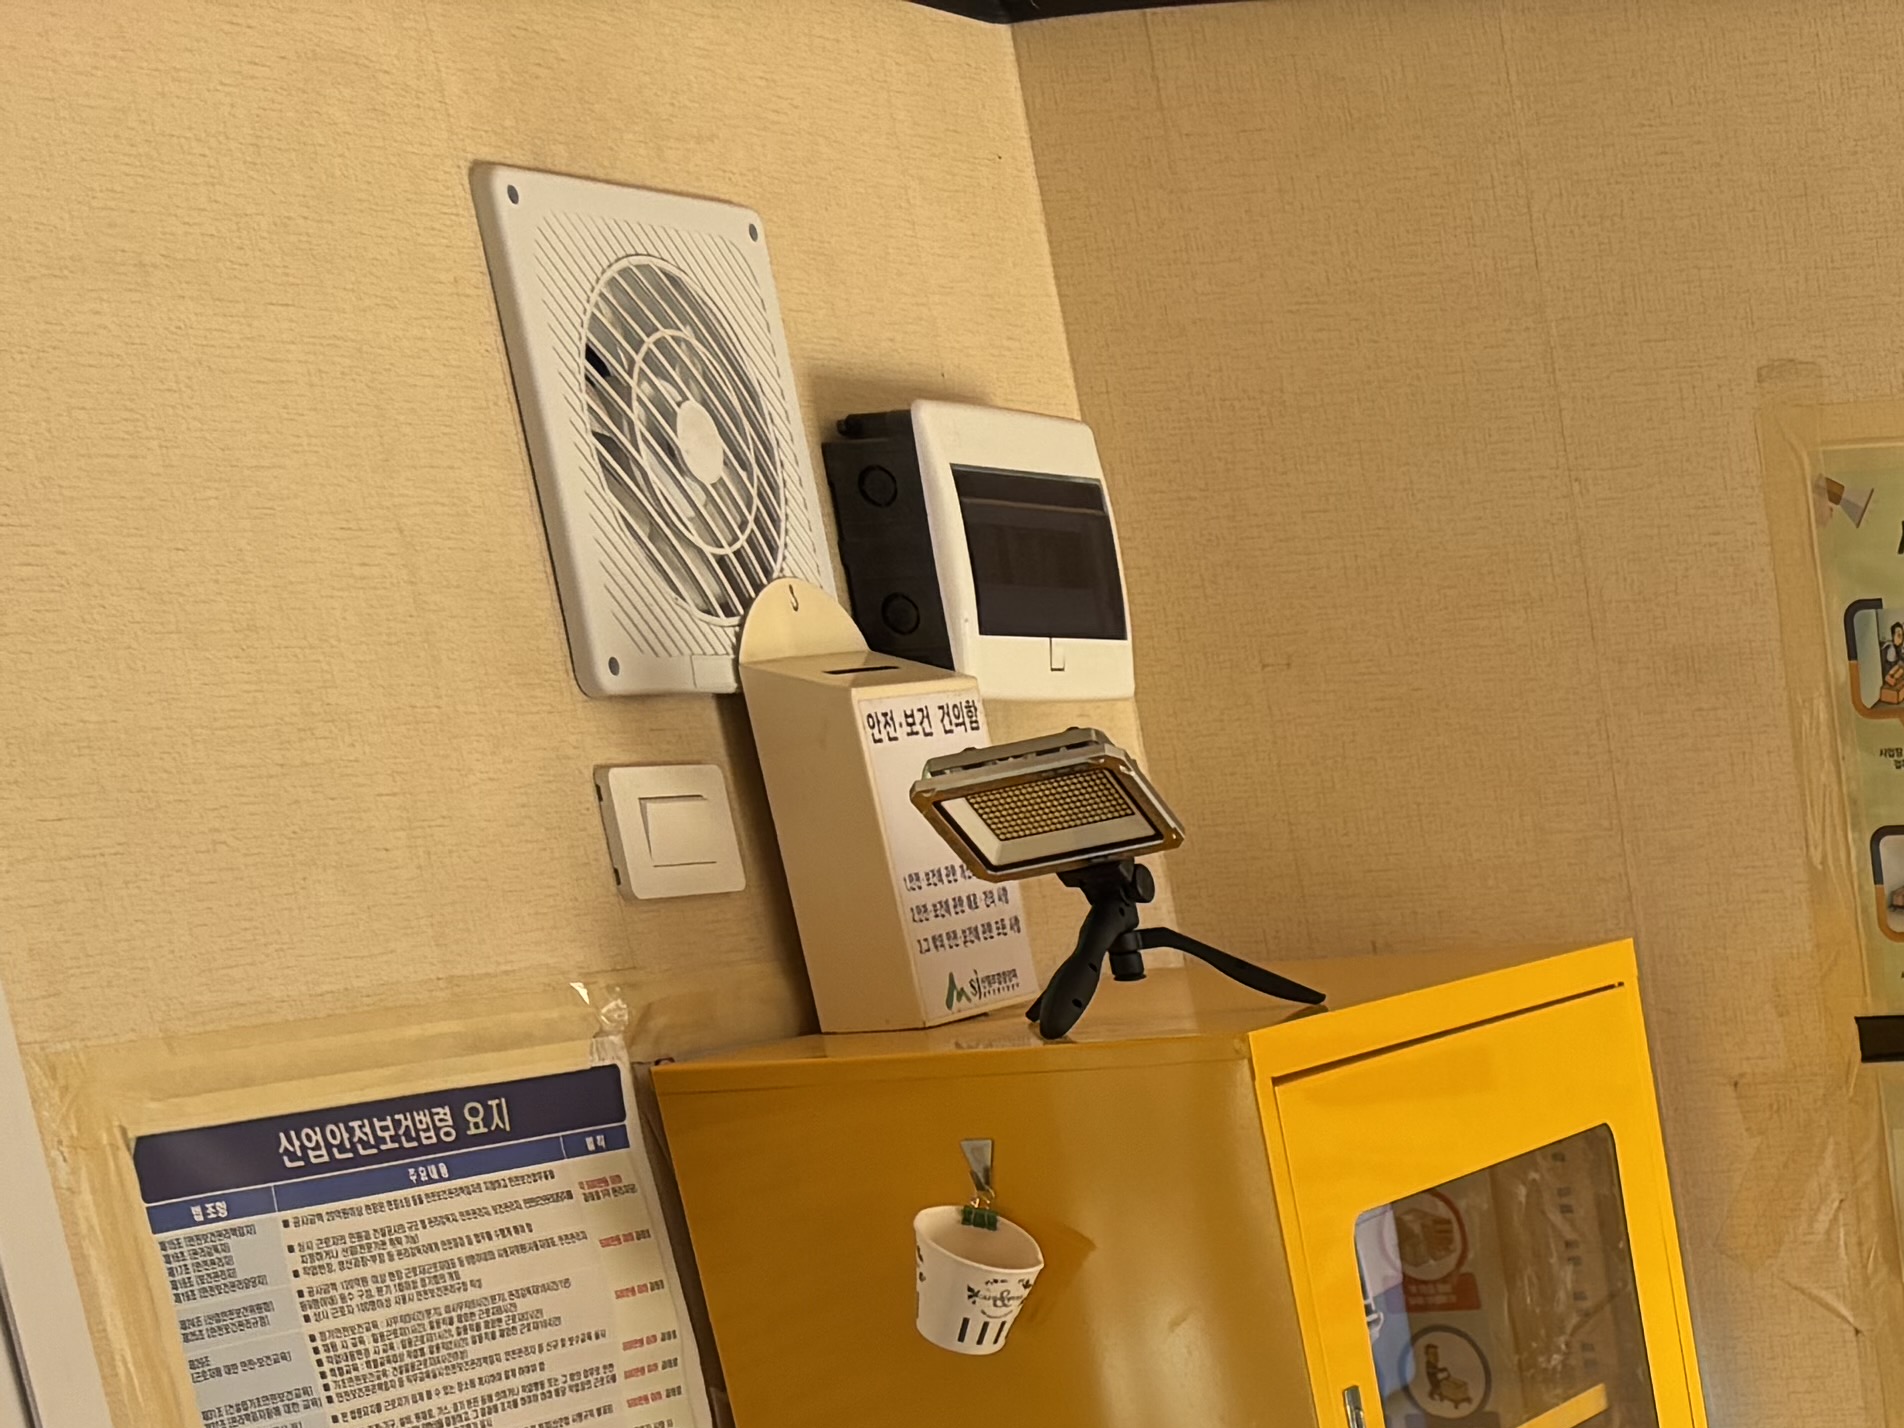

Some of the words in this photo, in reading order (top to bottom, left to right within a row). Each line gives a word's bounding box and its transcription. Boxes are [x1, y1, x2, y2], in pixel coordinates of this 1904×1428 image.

[866, 708, 934, 745] 안전·보건
[937, 700, 980, 735] 건의함
[278, 1104, 457, 1170] 산업안전보건법령
[463, 1097, 511, 1137] 요지
